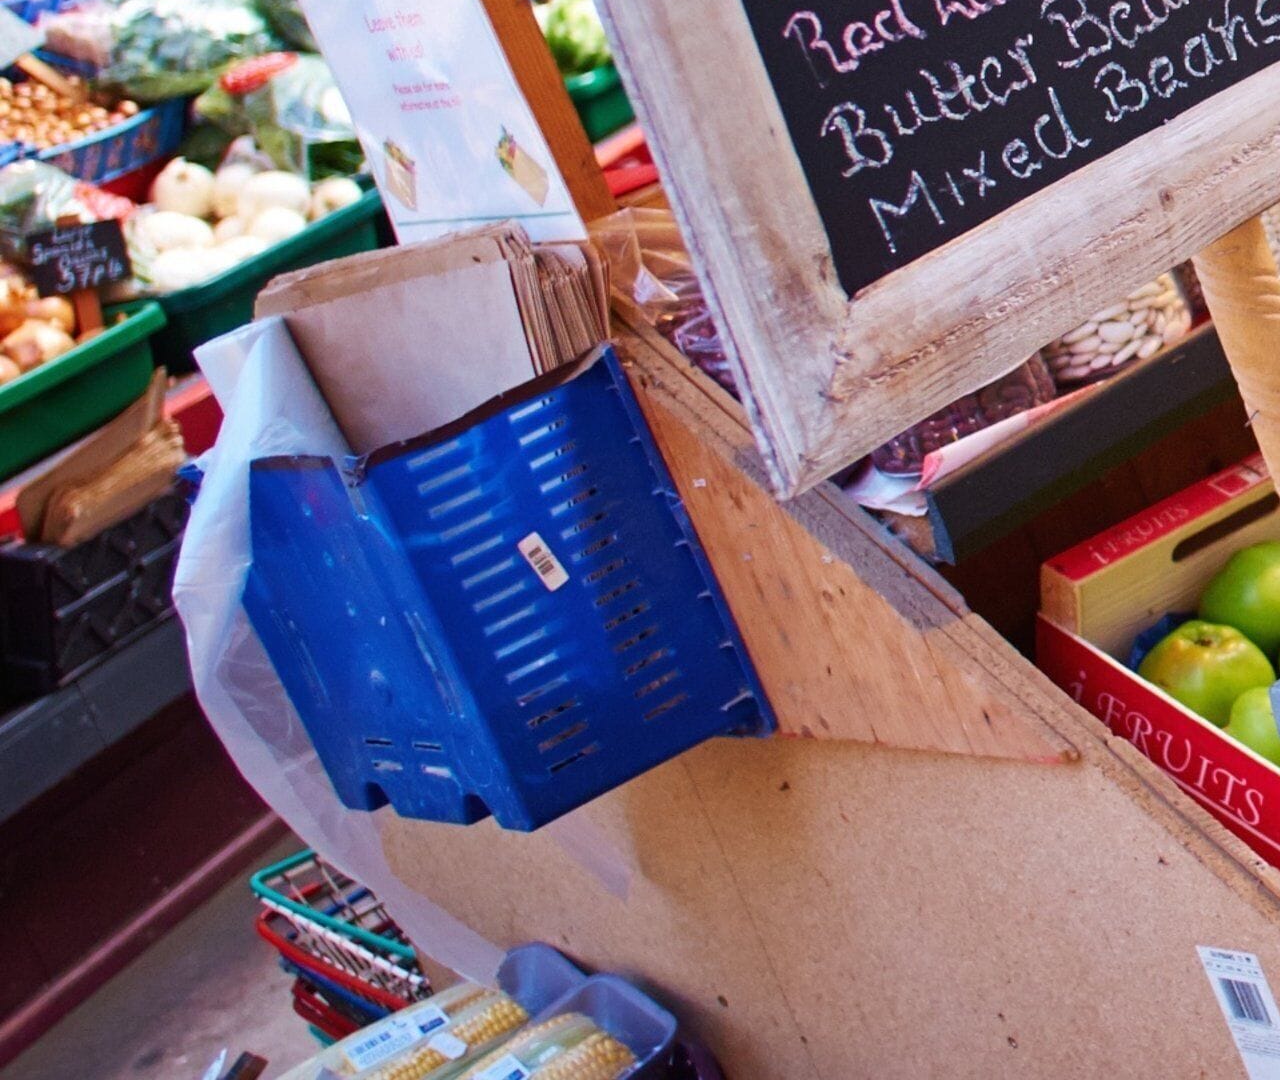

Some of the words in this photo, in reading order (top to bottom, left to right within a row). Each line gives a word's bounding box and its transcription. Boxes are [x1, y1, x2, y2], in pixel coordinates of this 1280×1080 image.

[821, 33, 1038, 178] Butter
[868, 86, 1092, 255] Mixed
[1097, 692, 1265, 826] FRUITS
